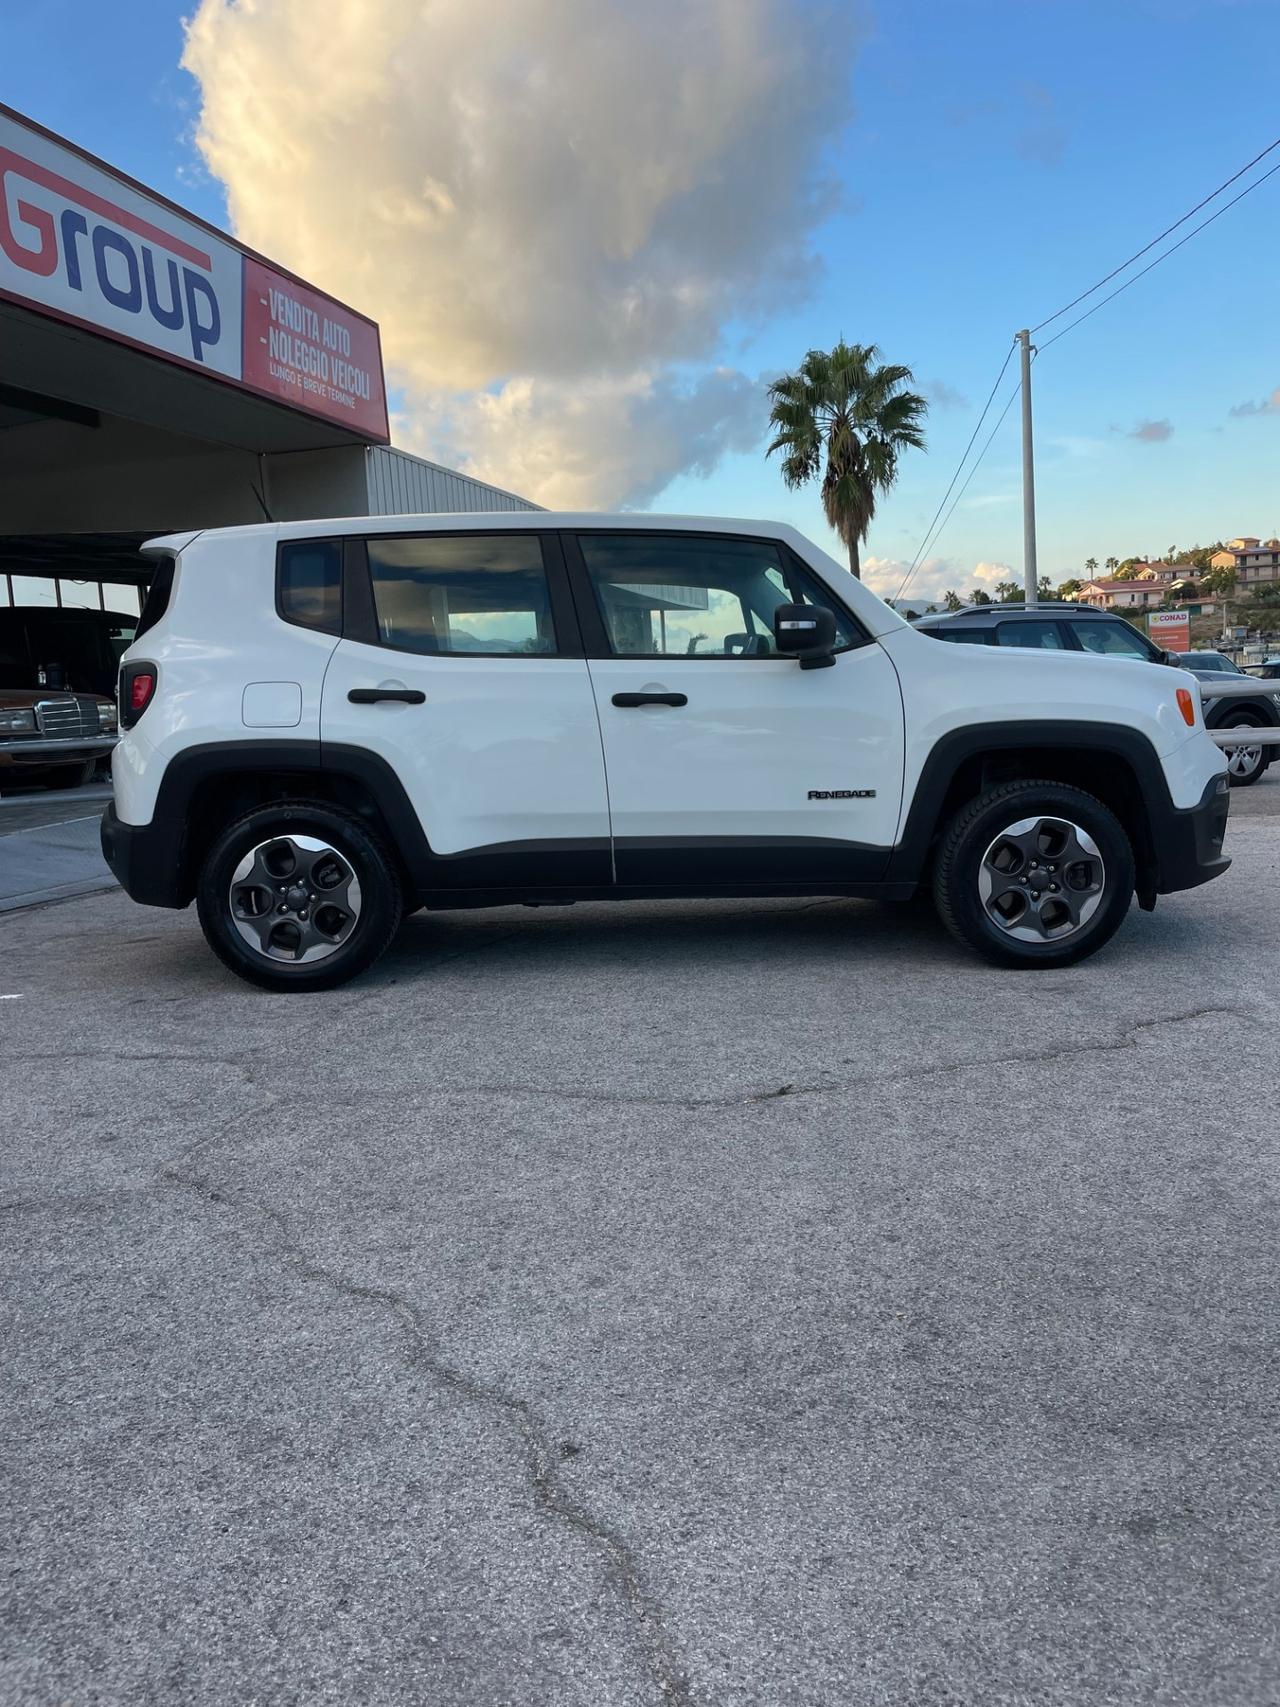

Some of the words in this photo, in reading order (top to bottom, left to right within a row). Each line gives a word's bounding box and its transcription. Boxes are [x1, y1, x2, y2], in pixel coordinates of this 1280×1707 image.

[323, 318, 351, 358] AUTO
[270, 361, 296, 385] LUNGO
[298, 374, 302, 387] E
[303, 376, 327, 397] BREVE
[328, 386, 356, 409] TERMINE
[331, 356, 370, 401] VEICOLI
[1160, 614, 1187, 622] CONAD
[807, 790, 876, 800] RENEGADE
